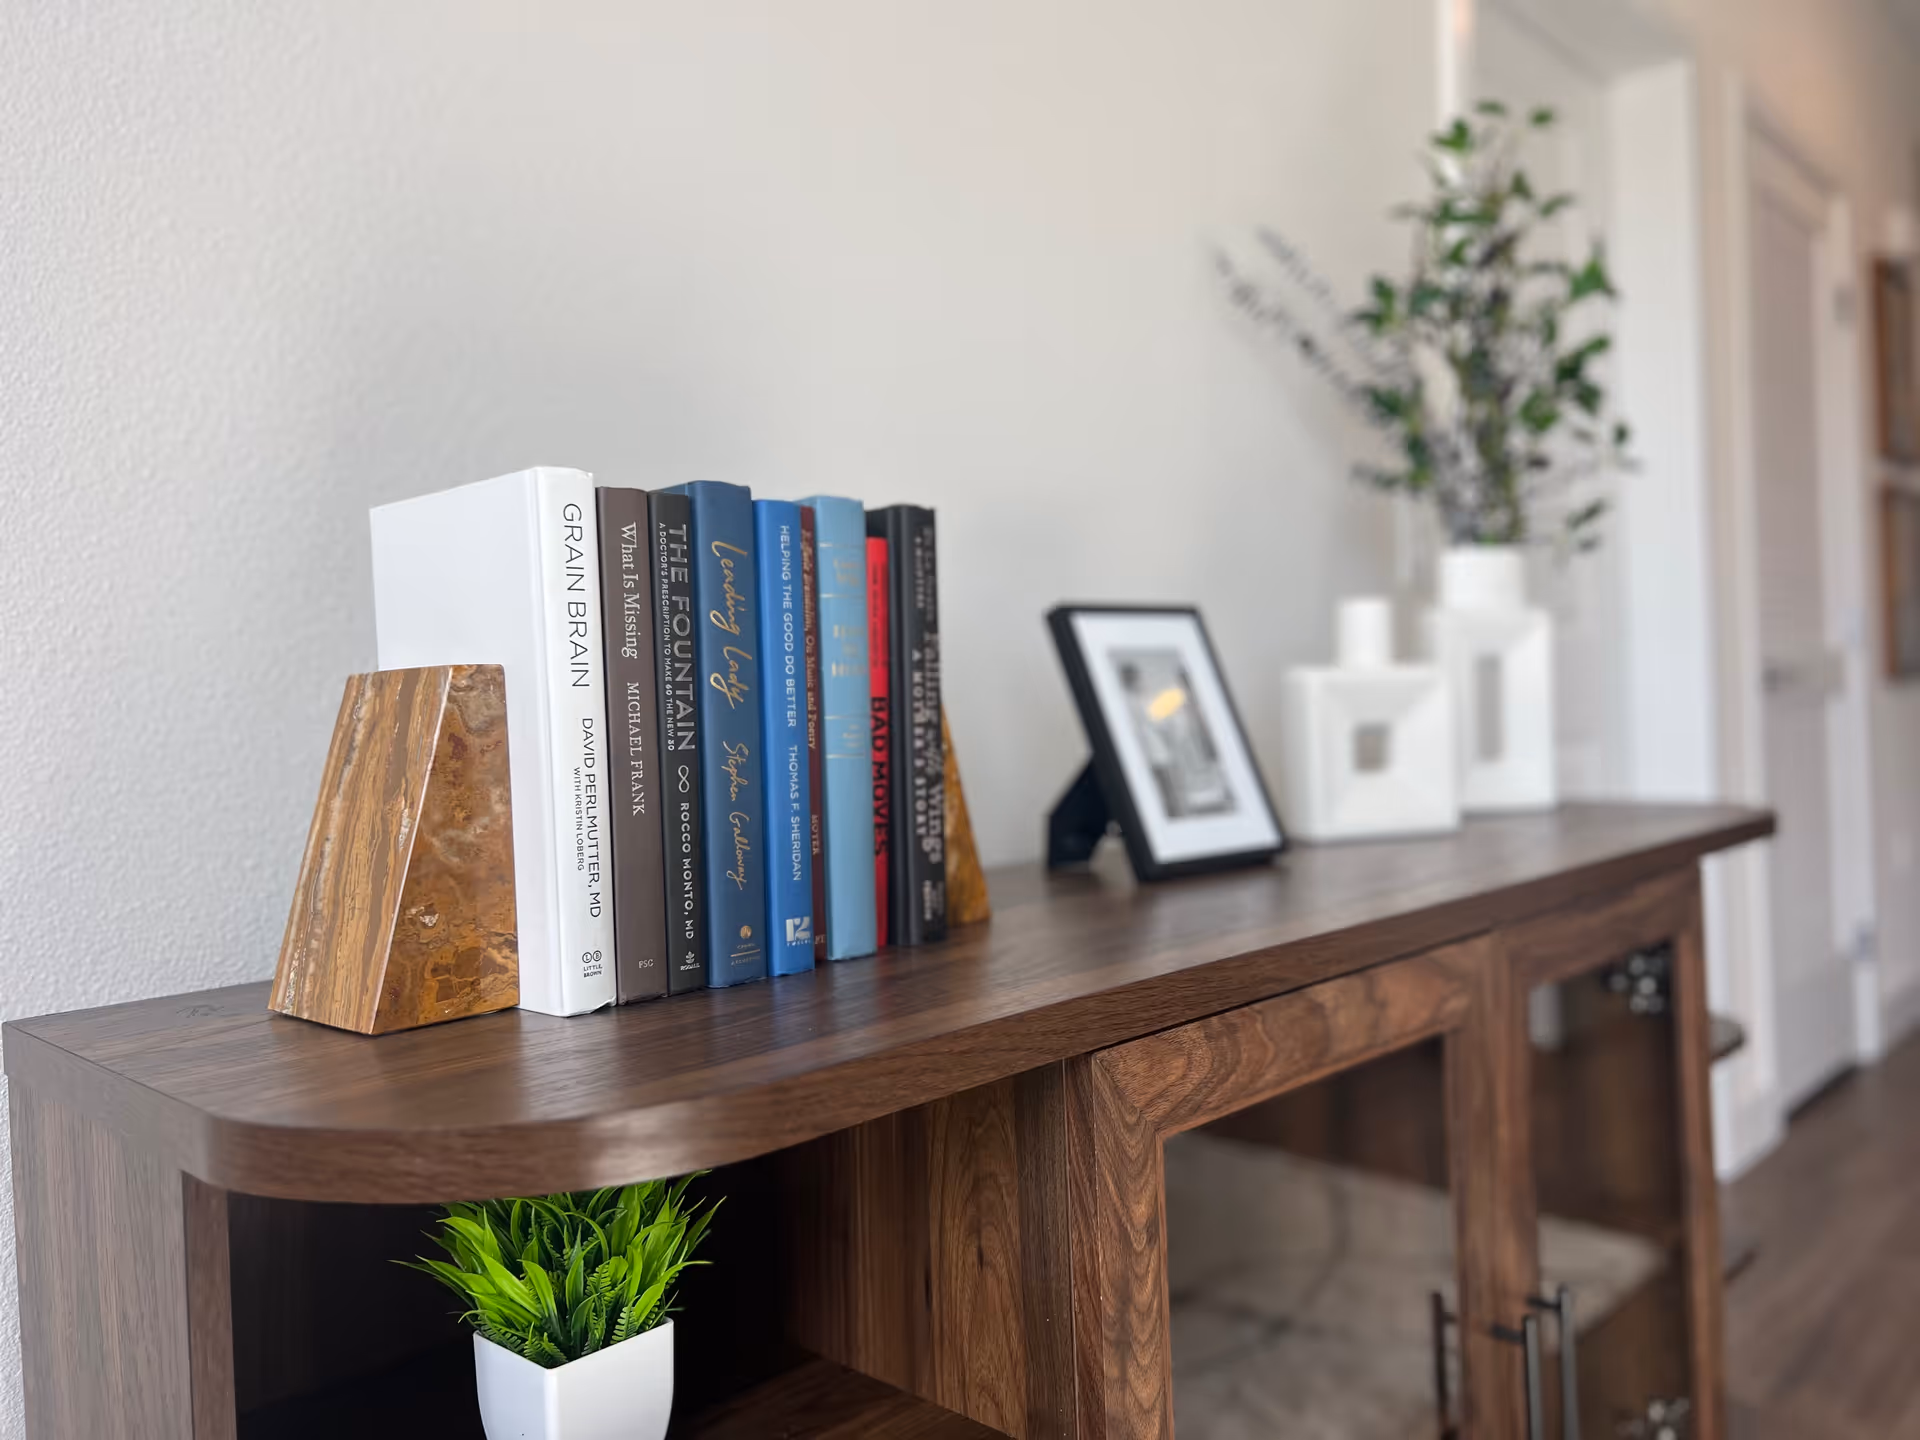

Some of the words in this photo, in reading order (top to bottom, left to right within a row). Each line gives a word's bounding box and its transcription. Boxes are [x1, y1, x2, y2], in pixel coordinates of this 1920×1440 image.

[563, 503, 585, 592] GRAIN
[621, 522, 637, 570] What
[659, 531, 668, 576] DOCTOR'S
[669, 524, 688, 583] THE
[780, 525, 792, 581] HELPING
[623, 573, 639, 588] Is
[710, 540, 748, 636] Leading
[783, 584, 793, 609] THE
[621, 592, 641, 659] Missing
[661, 578, 671, 641] PRESCRIPTION
[784, 613, 794, 652] GOOD
[567, 602, 590, 687] BRAIN
[663, 643, 671, 655] TO
[785, 656, 795, 675] DO
[664, 658, 672, 683] MAKE
[665, 684, 673, 696] 60
[672, 595, 695, 751] FOUNTAIN
[710, 646, 753, 709] Lady
[627, 682, 643, 756] MICHAEL
[666, 697, 674, 716] THE
[785, 678, 797, 727] BETTER
[807, 691, 818, 711] and
[582, 718, 595, 768] DAVID
[573, 767, 581, 792] WITH
[630, 760, 645, 816] FRANK
[721, 741, 749, 801] Stephen
[789, 746, 799, 800] THOMAS
[574, 794, 583, 831] KRISTIN
[585, 774, 600, 888] PERLMUTTER,
[680, 802, 691, 853] ROCCO
[791, 803, 800, 813] F.
[576, 832, 585, 871] LOBERG
[726, 811, 749, 890] Galloway
[791, 816, 802, 881] SHERIDAN
[590, 892, 601, 918] MD
[682, 858, 694, 916] MONTO,
[685, 919, 694, 939] MD
[583, 970, 602, 978] BROWN
